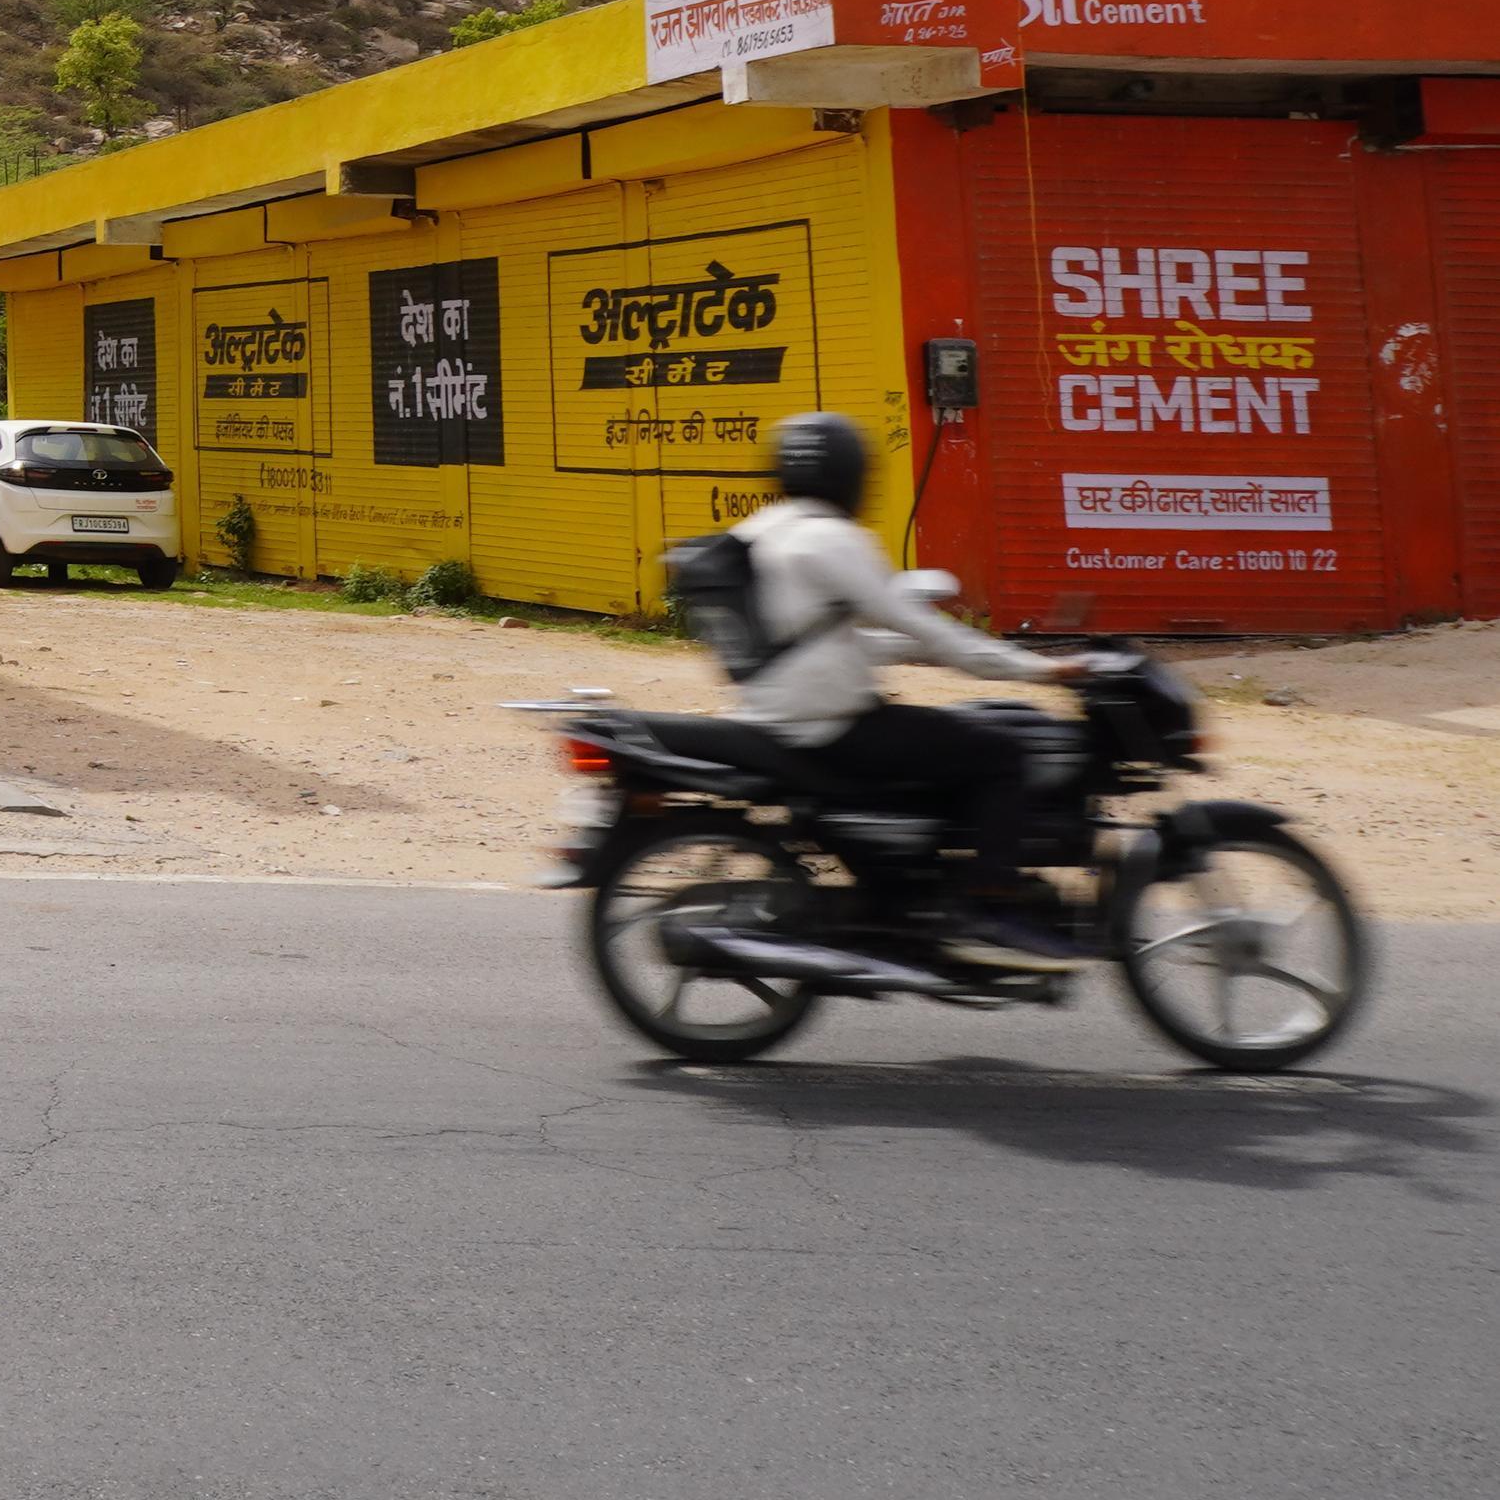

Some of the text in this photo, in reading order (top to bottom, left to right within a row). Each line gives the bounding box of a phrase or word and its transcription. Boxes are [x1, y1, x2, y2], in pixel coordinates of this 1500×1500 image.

[580, 260, 780, 350] अल्ट्राटेक
[1051, 247, 1313, 321] SHREE
[204, 308, 307, 372] अल्ट्राटेक
[400, 290, 469, 347] देश का
[1056, 320, 1315, 370] जंग रोधक
[120, 338, 138, 368] का
[680, 411, 705, 444] की
[712, 411, 759, 444] पसंद
[1059, 374, 1320, 434] CEMENT
[1077, 487, 1113, 513] घर
[1119, 480, 1153, 513] की
[1209, 482, 1263, 513] सालों
[1268, 489, 1318, 513] साल
[1066, 548, 1165, 570] Customer
[1238, 551, 1284, 570] 1800
[1289, 551, 1307, 570] 10
[1313, 549, 1337, 571] 22
